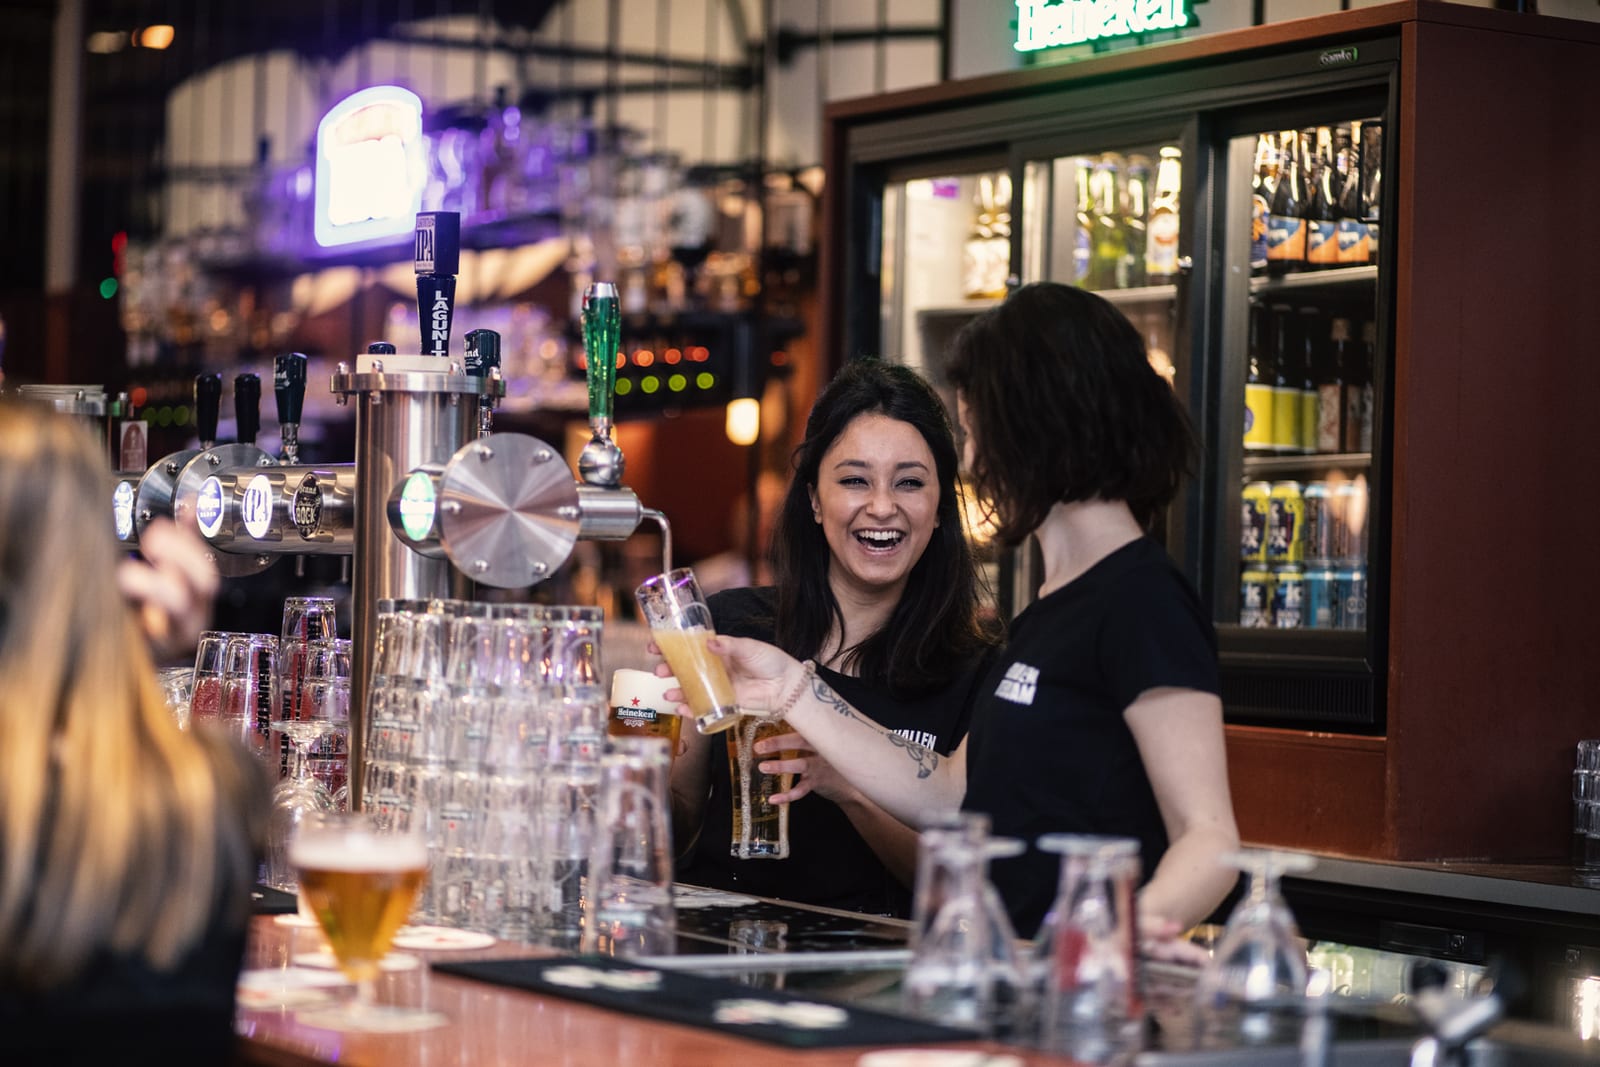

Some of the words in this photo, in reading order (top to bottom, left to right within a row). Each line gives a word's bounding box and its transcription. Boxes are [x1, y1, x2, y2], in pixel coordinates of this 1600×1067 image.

[416, 229, 434, 261] IPA
[244, 489, 268, 522] IPA
[296, 507, 316, 524] BOCK
[617, 707, 655, 719] Heineken
